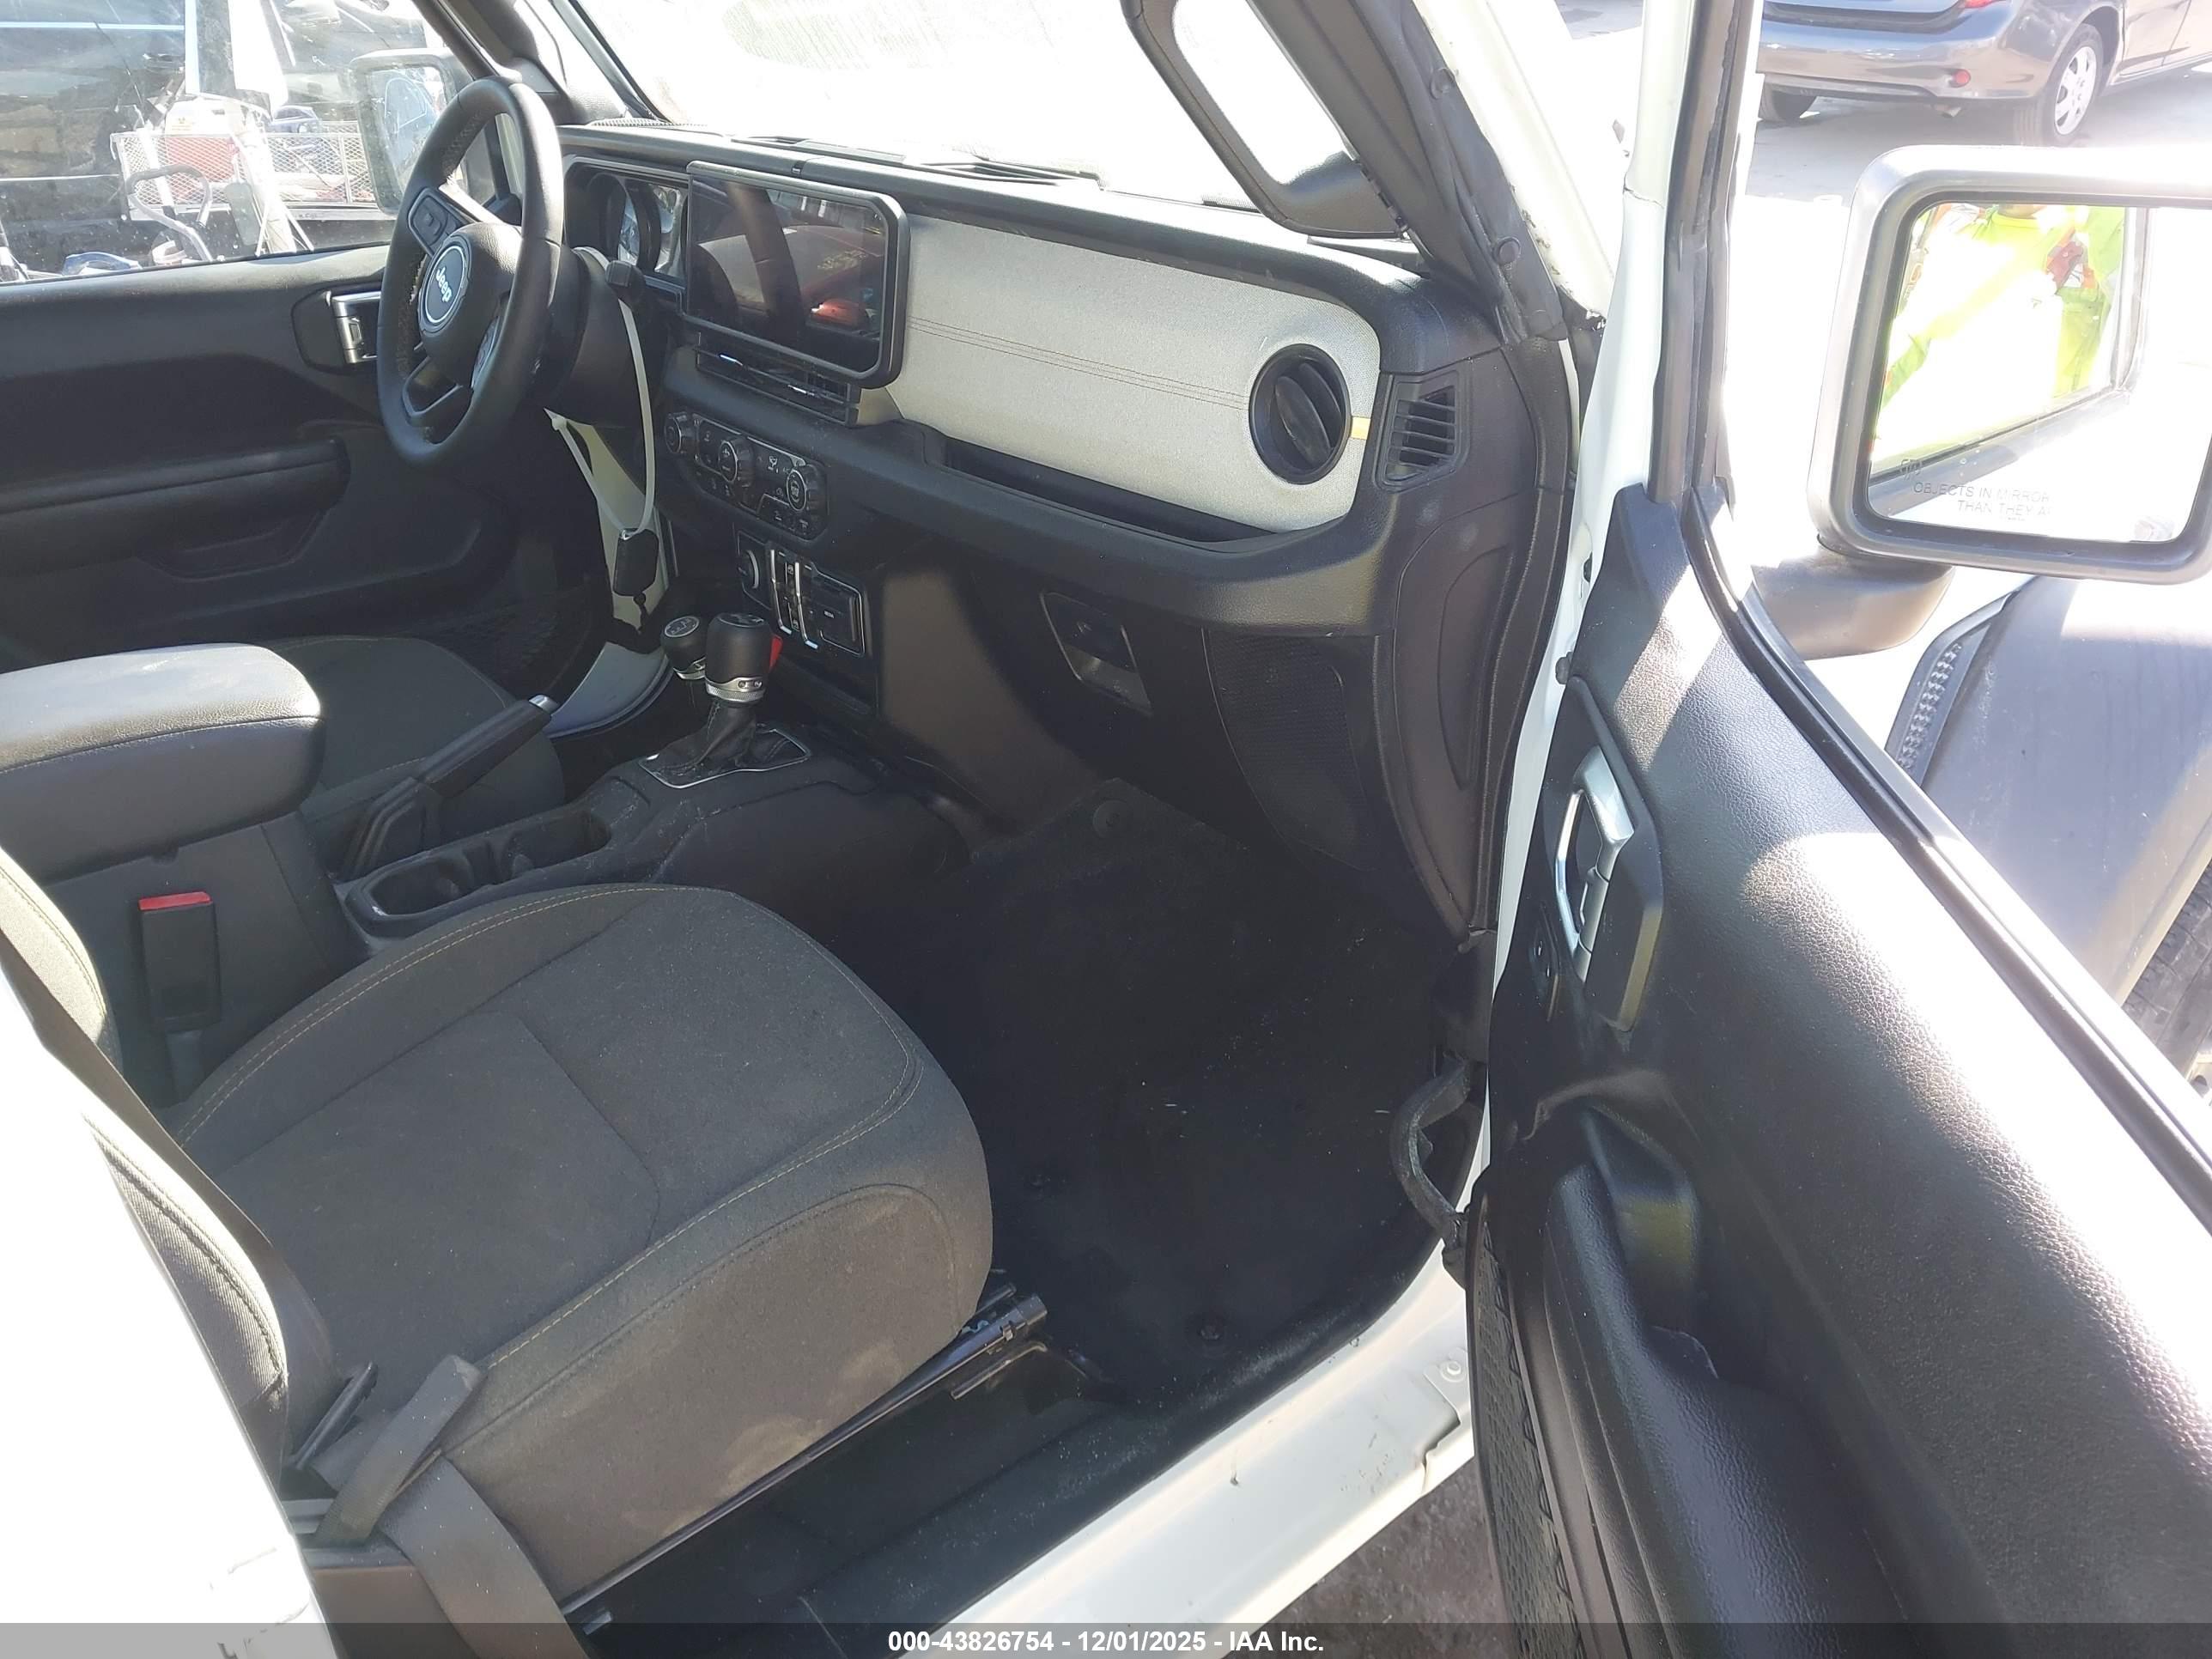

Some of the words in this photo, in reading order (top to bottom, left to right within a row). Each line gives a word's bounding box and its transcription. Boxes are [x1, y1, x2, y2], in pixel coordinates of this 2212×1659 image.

[435, 266, 453, 302] Jeep
[1913, 481, 1974, 498] OBJECTS
[1978, 487, 1992, 499] IN
[1958, 500, 1992, 514] THAN
[1998, 502, 2033, 516] THEY
